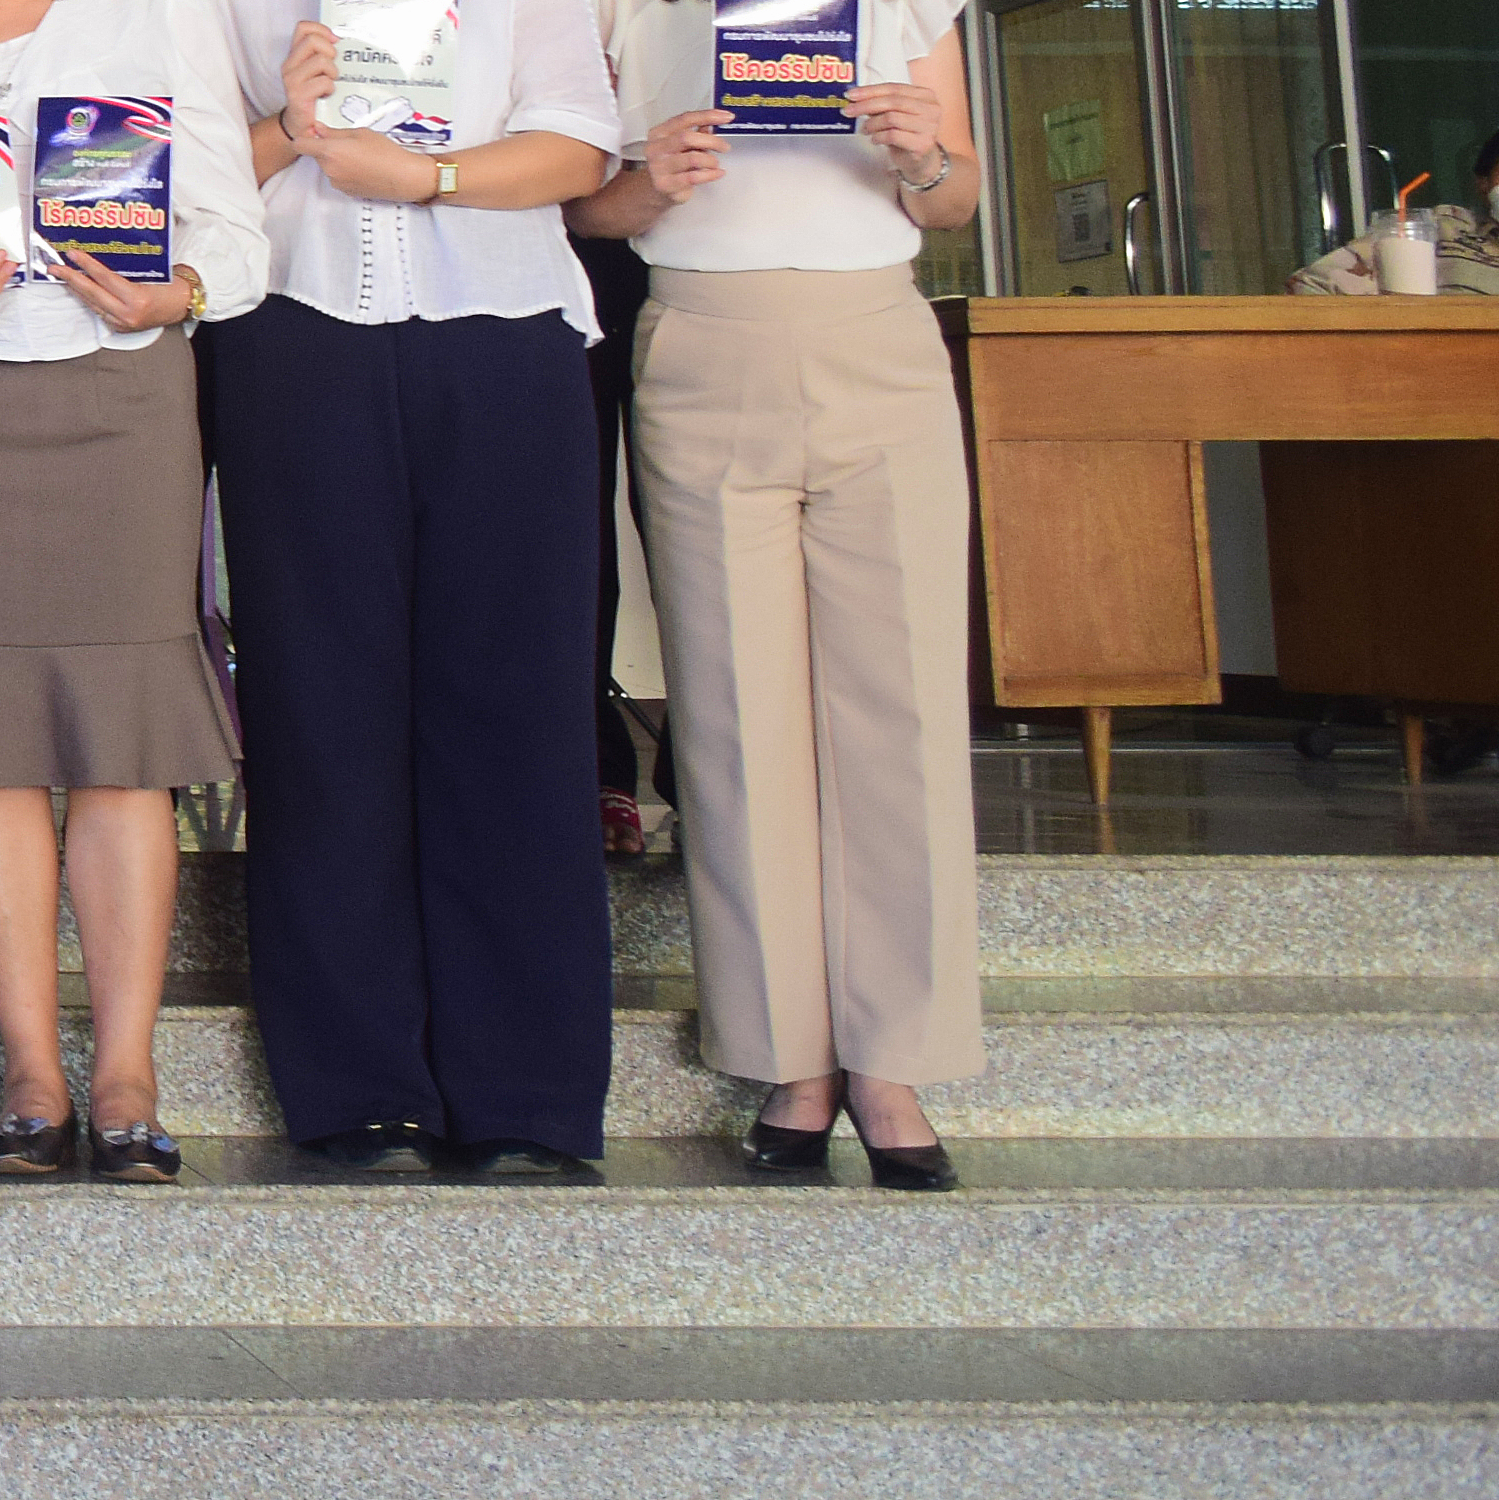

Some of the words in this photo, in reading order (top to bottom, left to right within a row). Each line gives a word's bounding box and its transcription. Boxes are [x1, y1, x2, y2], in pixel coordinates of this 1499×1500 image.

[719, 52, 854, 83] ไร้คอร์รัปชัน
[38, 198, 165, 230] ไร้คอร์รัปชัน
